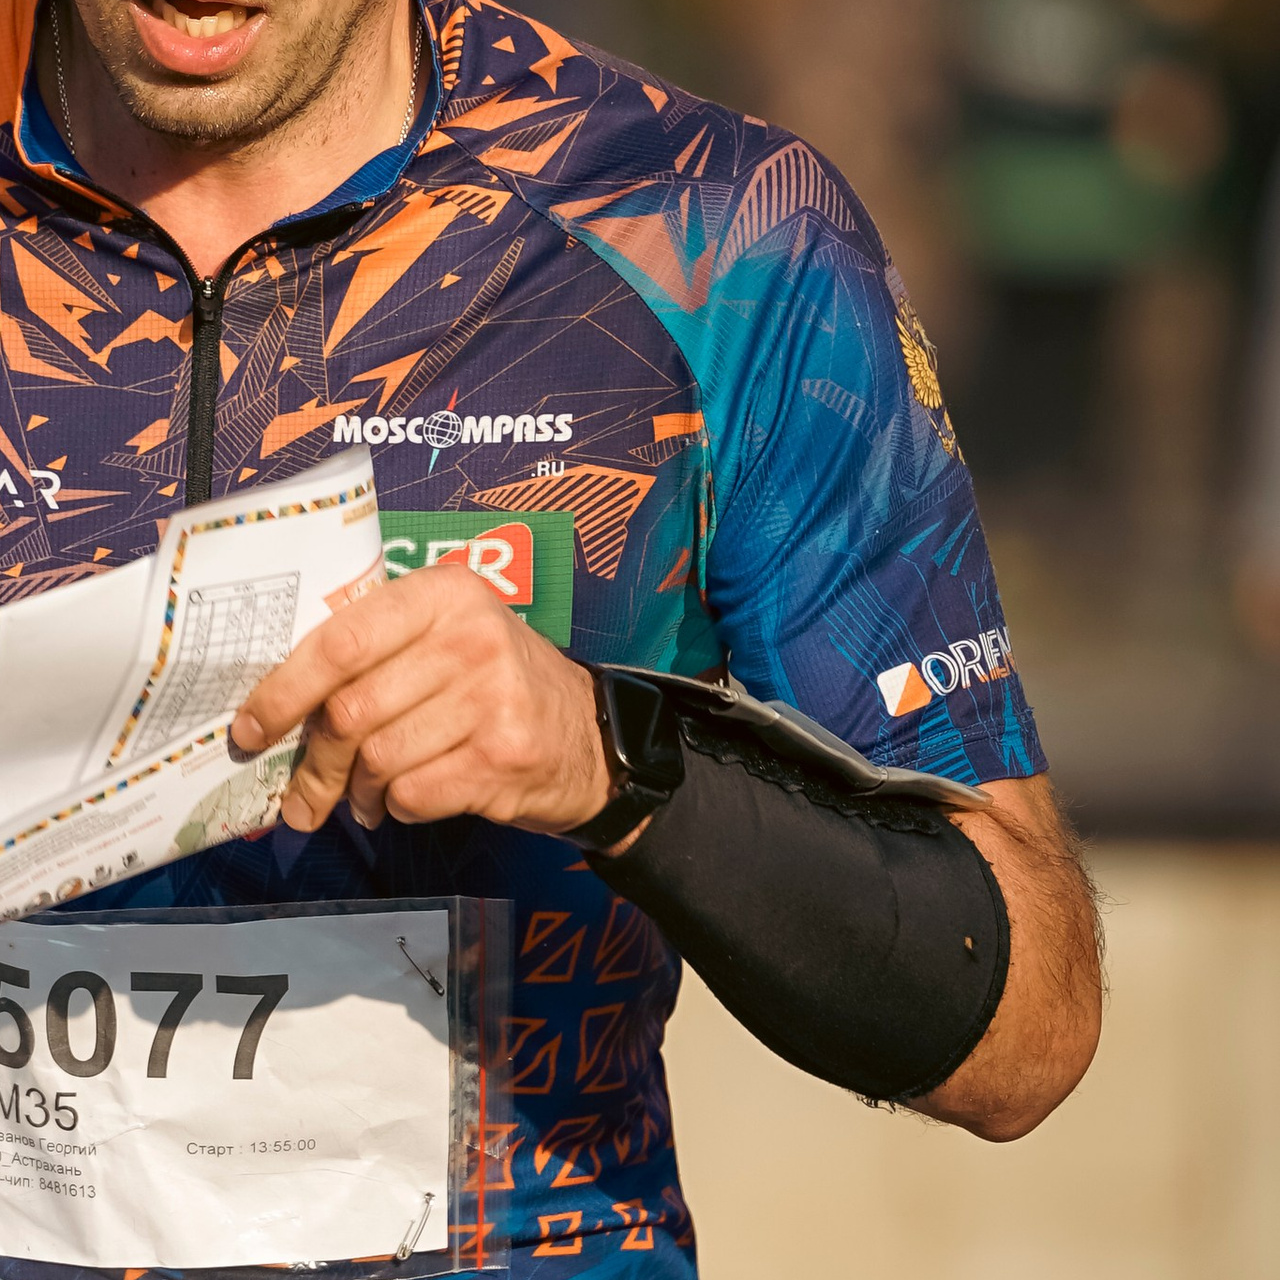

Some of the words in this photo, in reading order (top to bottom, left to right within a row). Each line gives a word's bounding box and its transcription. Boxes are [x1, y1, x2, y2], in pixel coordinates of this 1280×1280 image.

[531, 461, 565, 477] .RU
[39, 1137, 97, 1156] Георгий
[186, 1142, 234, 1157] Старт
[250, 1138, 316, 1153] 13:55:00
[39, 1177, 96, 1198] 8481613
